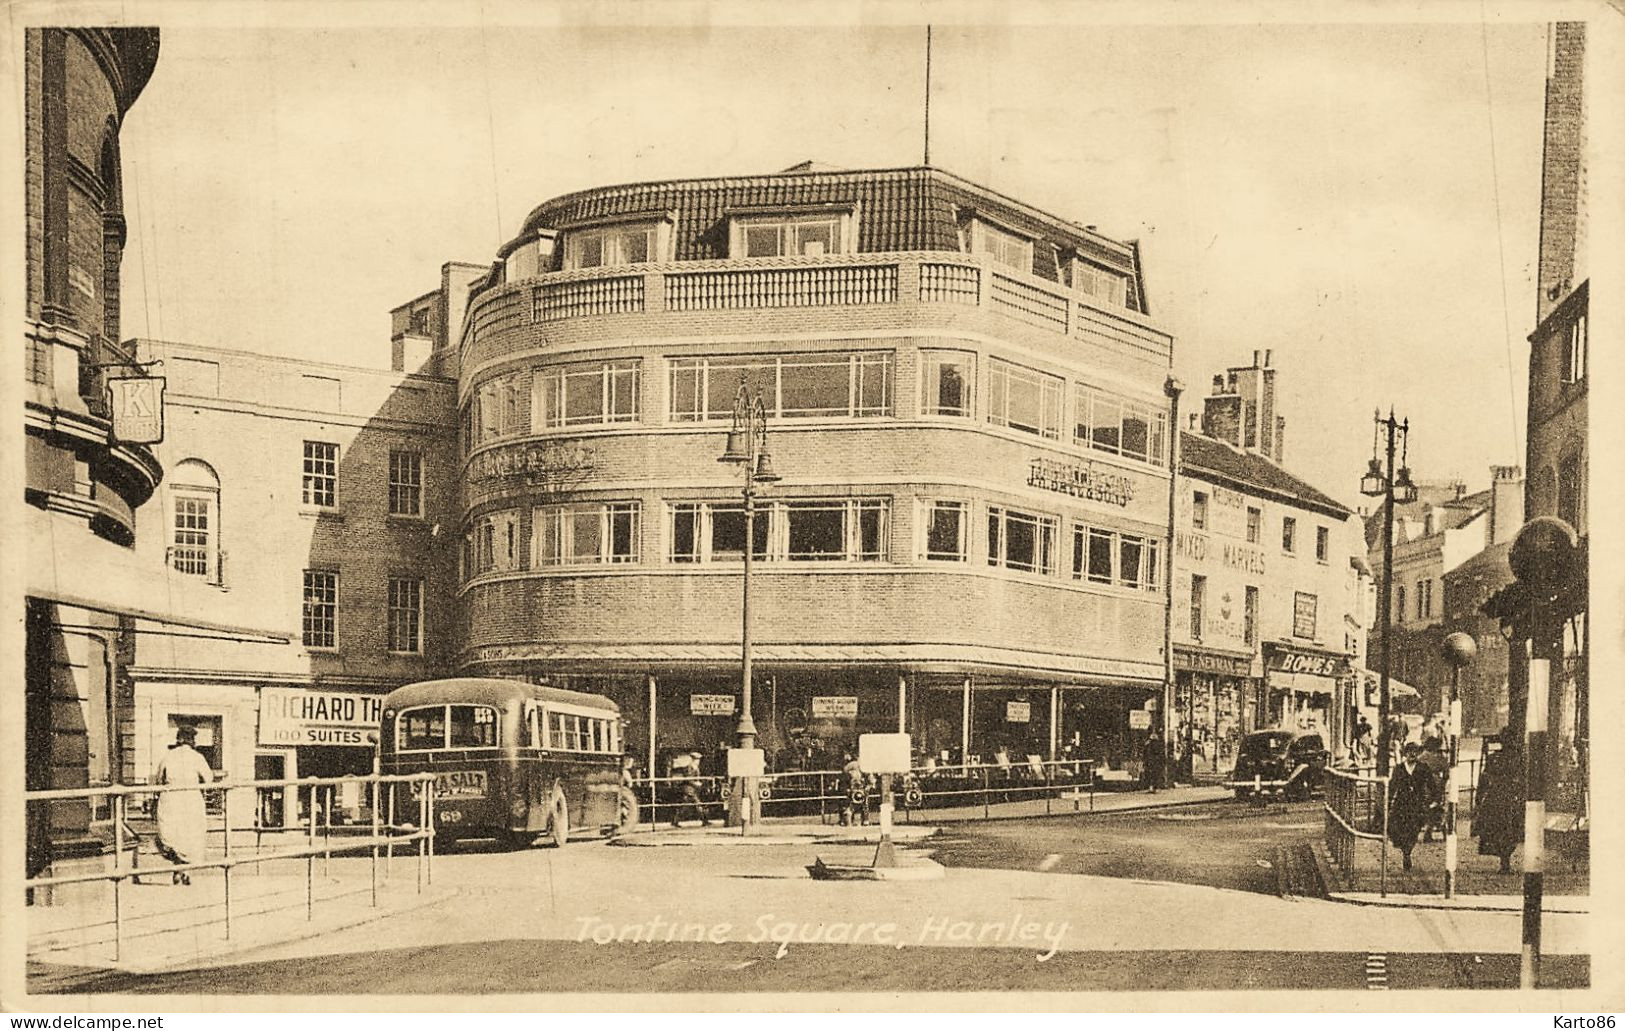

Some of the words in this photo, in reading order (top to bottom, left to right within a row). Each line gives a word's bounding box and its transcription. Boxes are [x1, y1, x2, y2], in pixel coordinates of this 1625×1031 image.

[121, 382, 153, 418] K
[1176, 532, 1206, 561] MIXED
[1223, 543, 1266, 575] MARVELS
[267, 693, 355, 722] RICHARD
[273, 729, 300, 741] 100
[307, 729, 362, 744] SUITES
[450, 772, 484, 789] SALT
